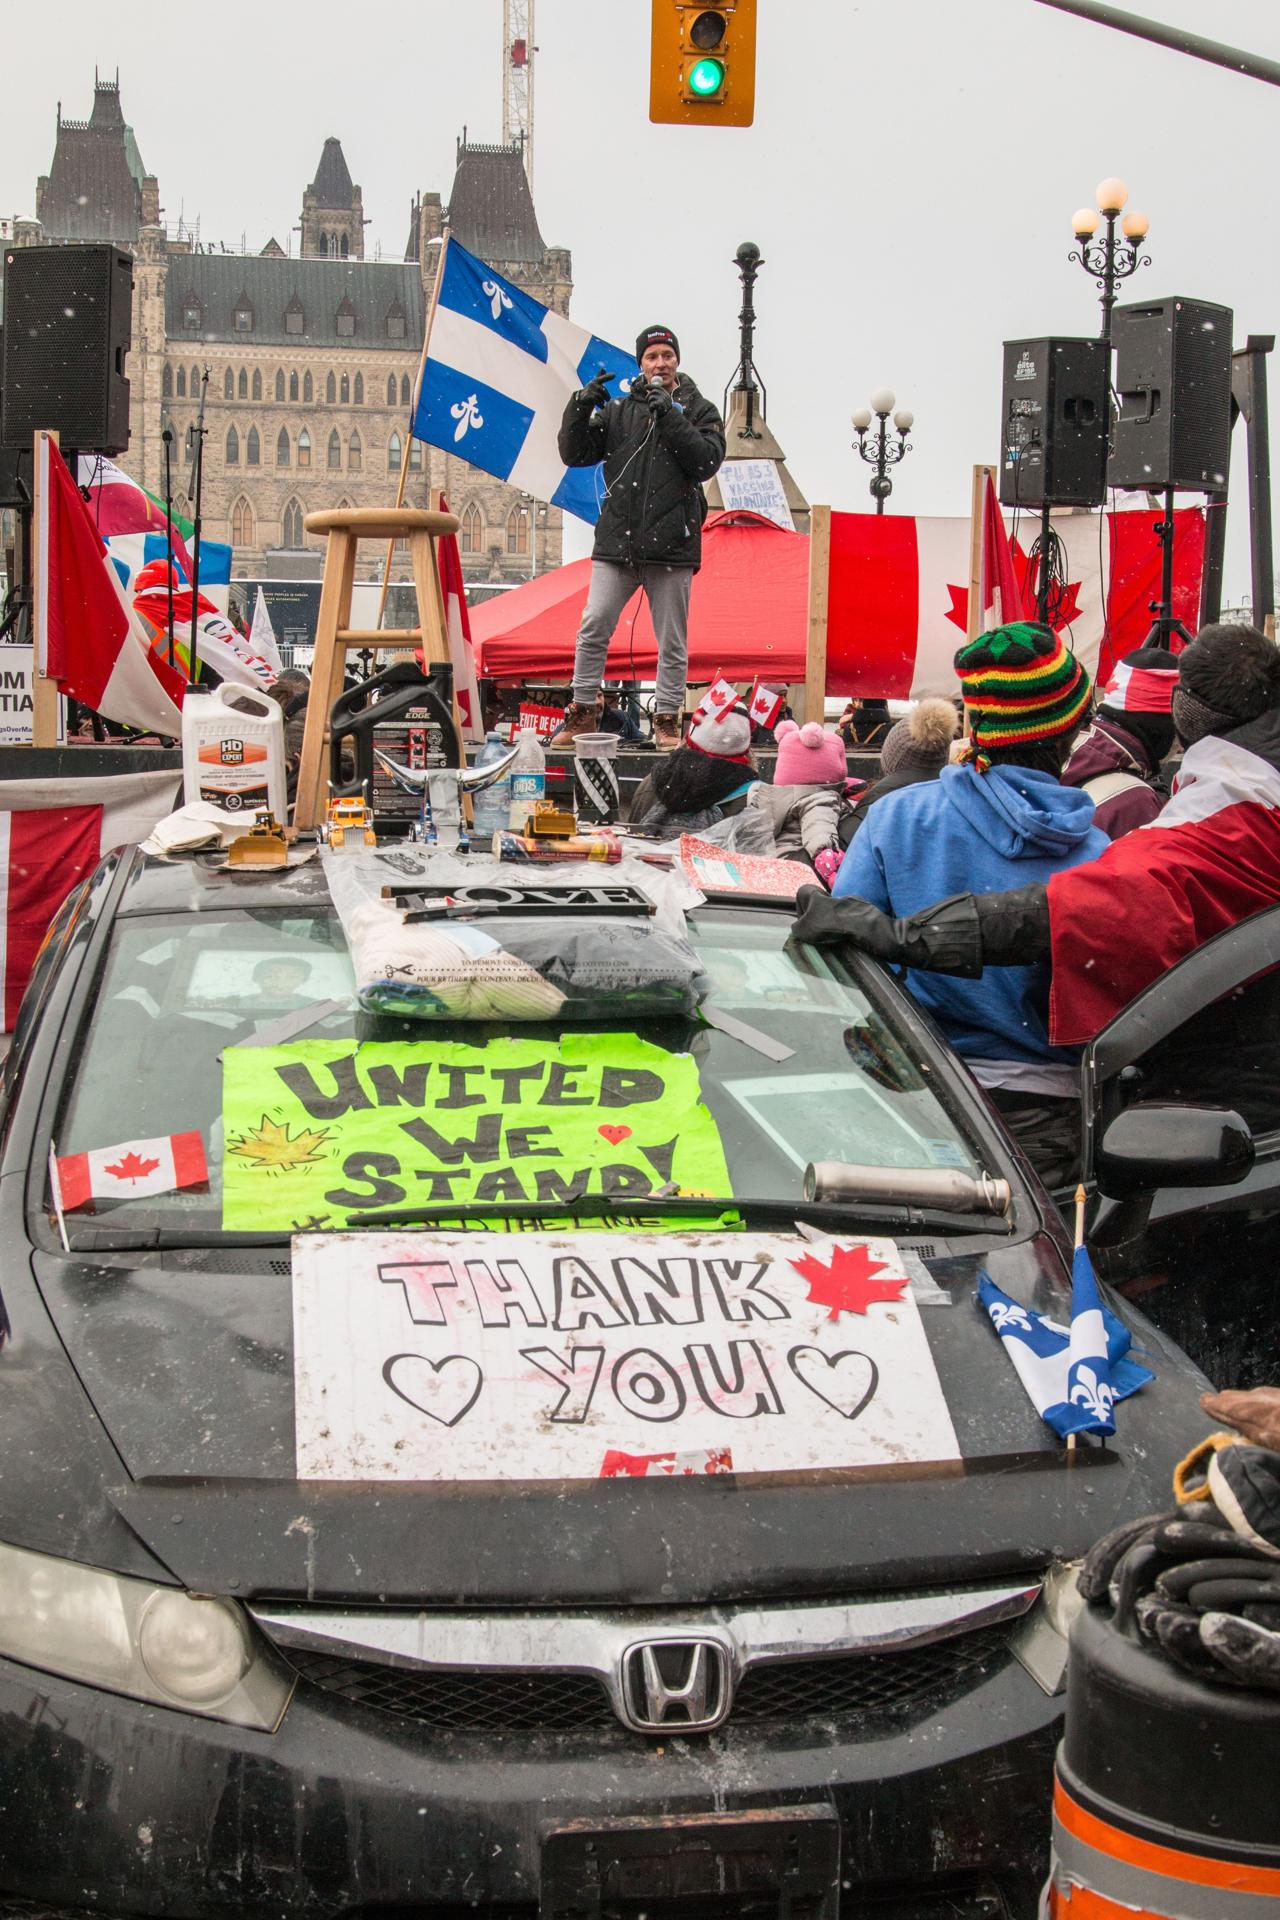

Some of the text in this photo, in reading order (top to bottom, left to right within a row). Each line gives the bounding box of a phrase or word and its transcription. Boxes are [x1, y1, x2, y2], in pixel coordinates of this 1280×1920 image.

[0, 671, 25, 689] M
[222, 741, 243, 752] HD
[540, 715, 550, 731] DE
[274, 1054, 665, 1120] UNITED
[398, 1113, 564, 1164] WE
[377, 1255, 792, 1331] THANK
[518, 1340, 785, 1424] YOU
